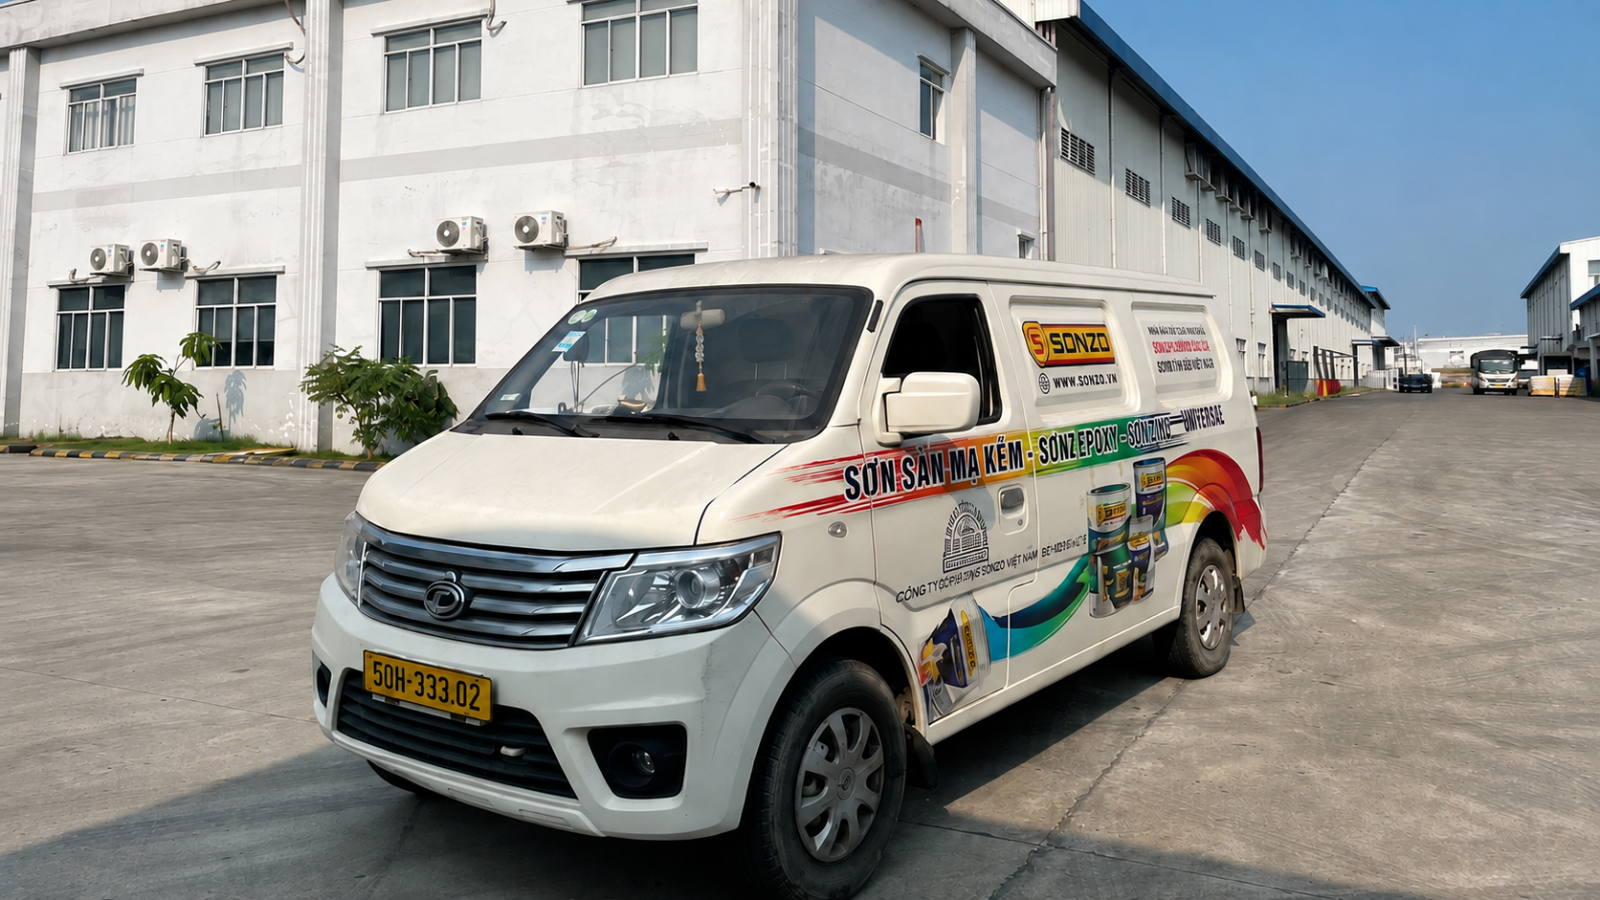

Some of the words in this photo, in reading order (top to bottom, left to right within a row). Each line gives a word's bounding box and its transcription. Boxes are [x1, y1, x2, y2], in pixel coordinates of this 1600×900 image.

[1049, 332, 1110, 354] SONZO
[1053, 373, 1118, 389] WWW.SONZO.VN
[844, 457, 896, 500] SƠN
[950, 448, 980, 483] MẠ
[1077, 425, 1117, 458] EPOXY
[981, 559, 1005, 576] SONZO
[373, 660, 481, 712] 50H-333.02
